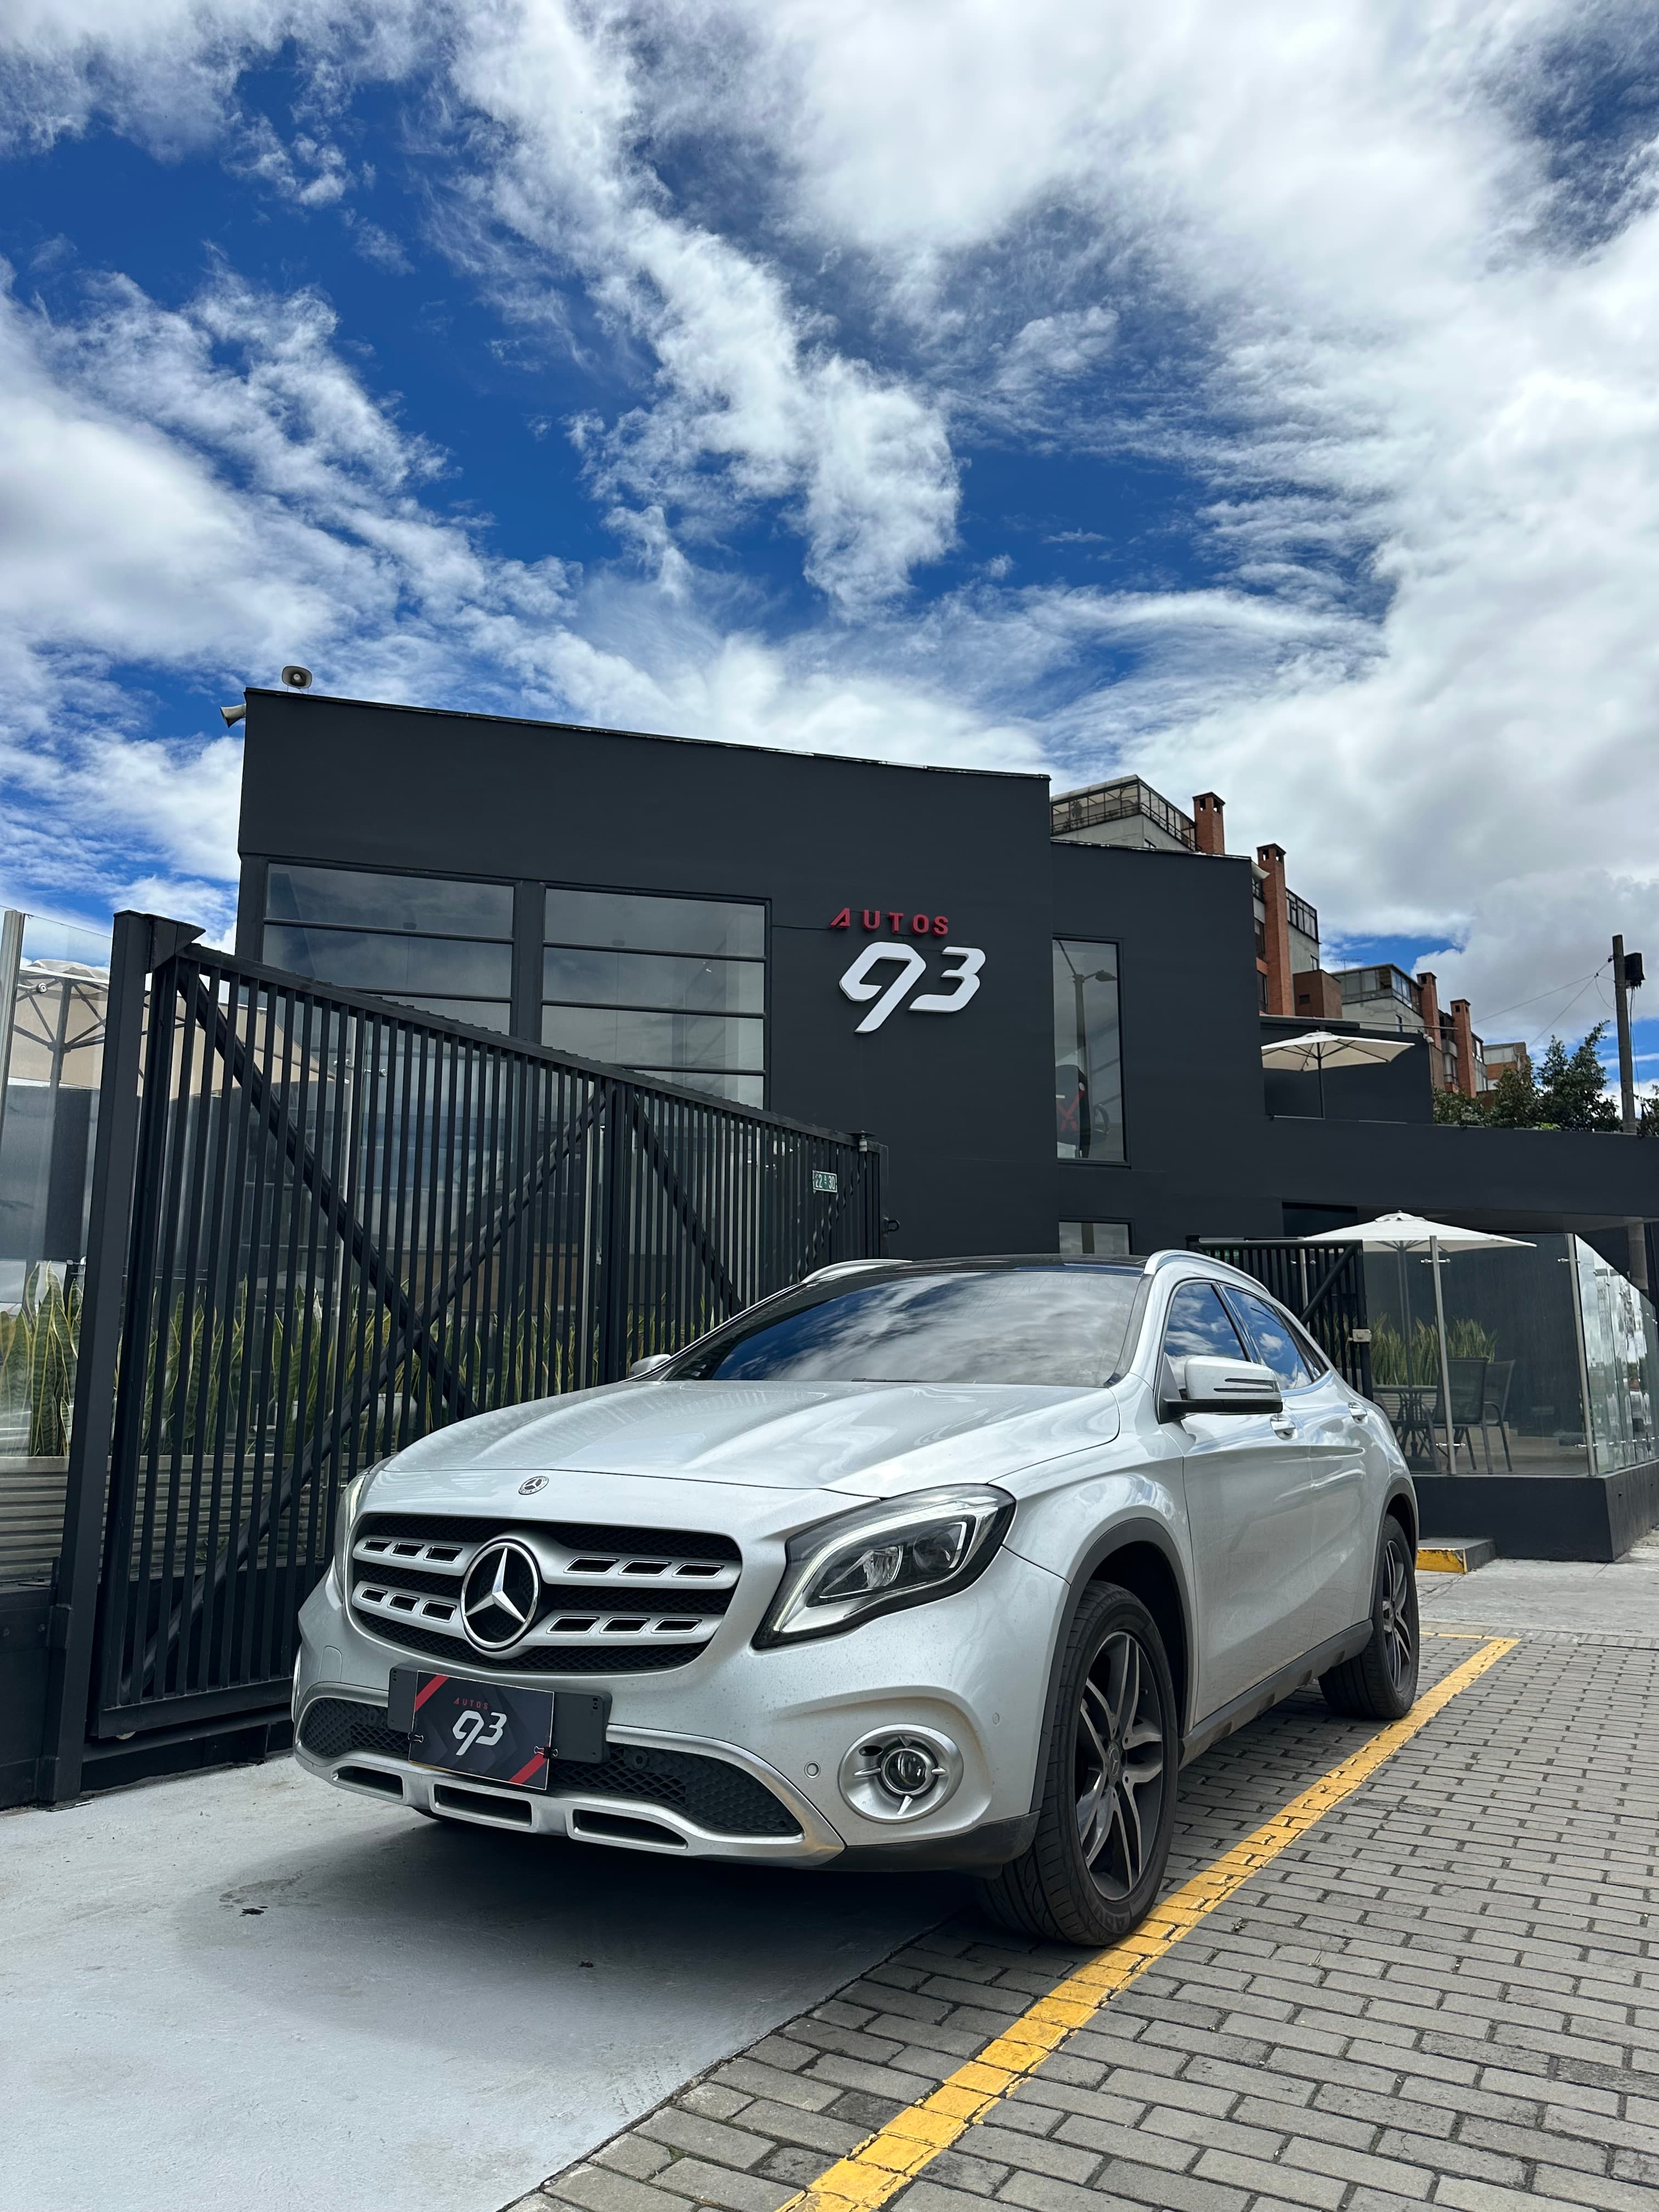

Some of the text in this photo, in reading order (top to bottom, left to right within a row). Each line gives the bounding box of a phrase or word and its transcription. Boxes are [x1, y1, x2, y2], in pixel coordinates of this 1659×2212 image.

[830, 908, 949, 936] AUTOS
[839, 941, 986, 1033] 93
[454, 1697, 488, 1709] AUTOS
[452, 1709, 507, 1756] 93
